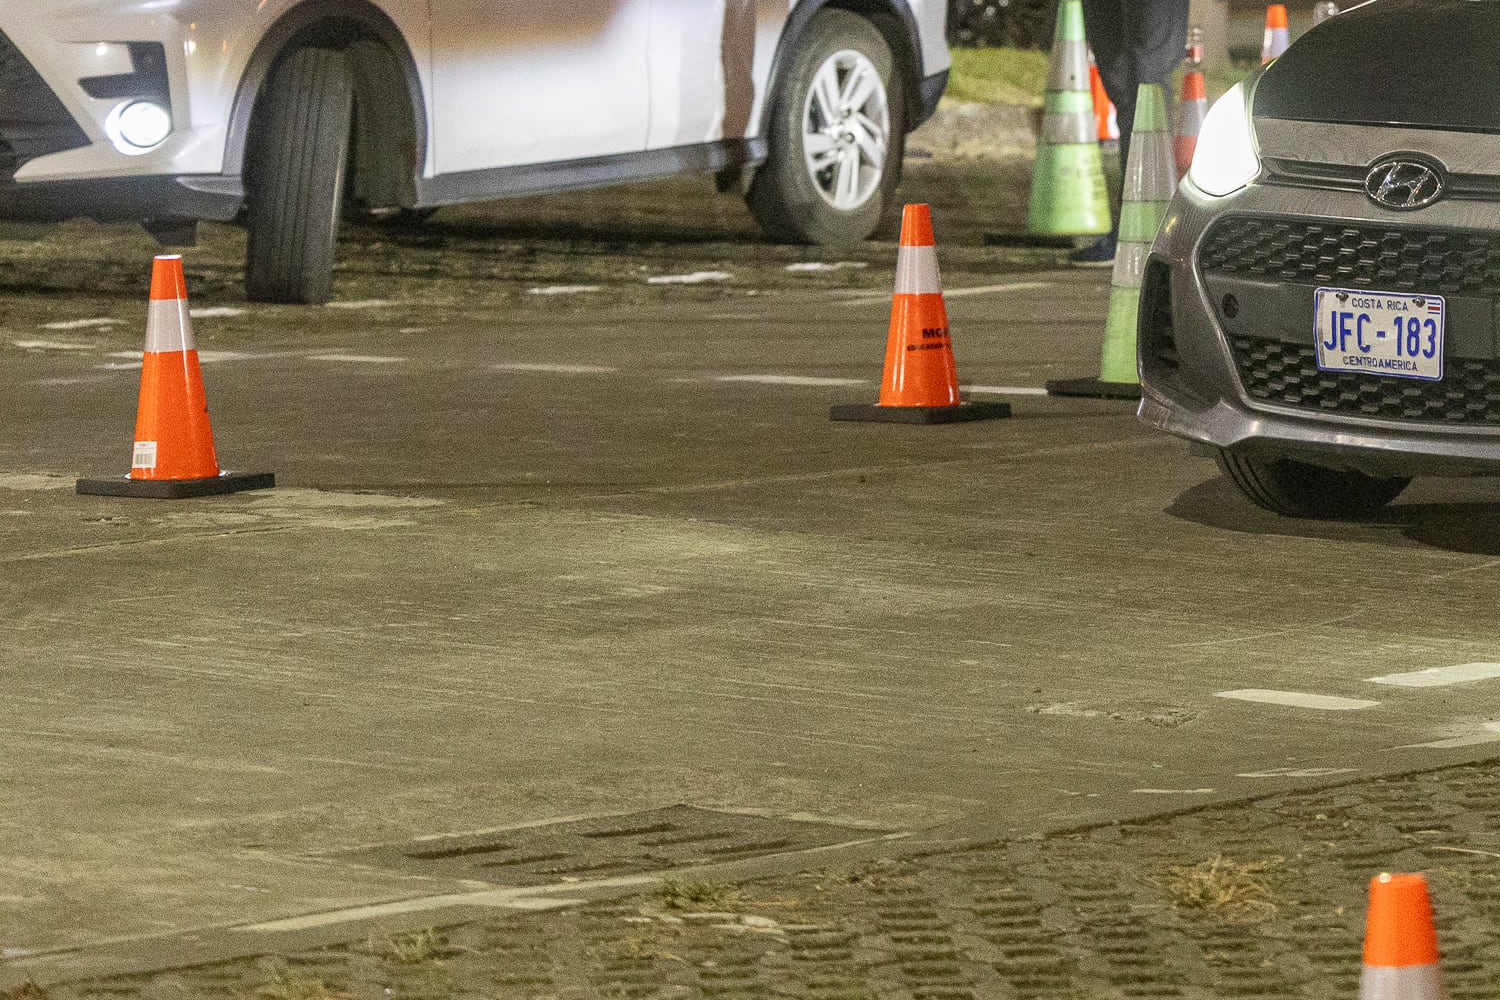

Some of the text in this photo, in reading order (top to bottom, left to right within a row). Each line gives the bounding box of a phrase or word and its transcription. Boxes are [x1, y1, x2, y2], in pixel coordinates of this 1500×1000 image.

[1351, 297, 1409, 312] COSTA RICA
[1323, 310, 1437, 359] JFC-183
[1342, 355, 1418, 372] CENTROAMERICA
